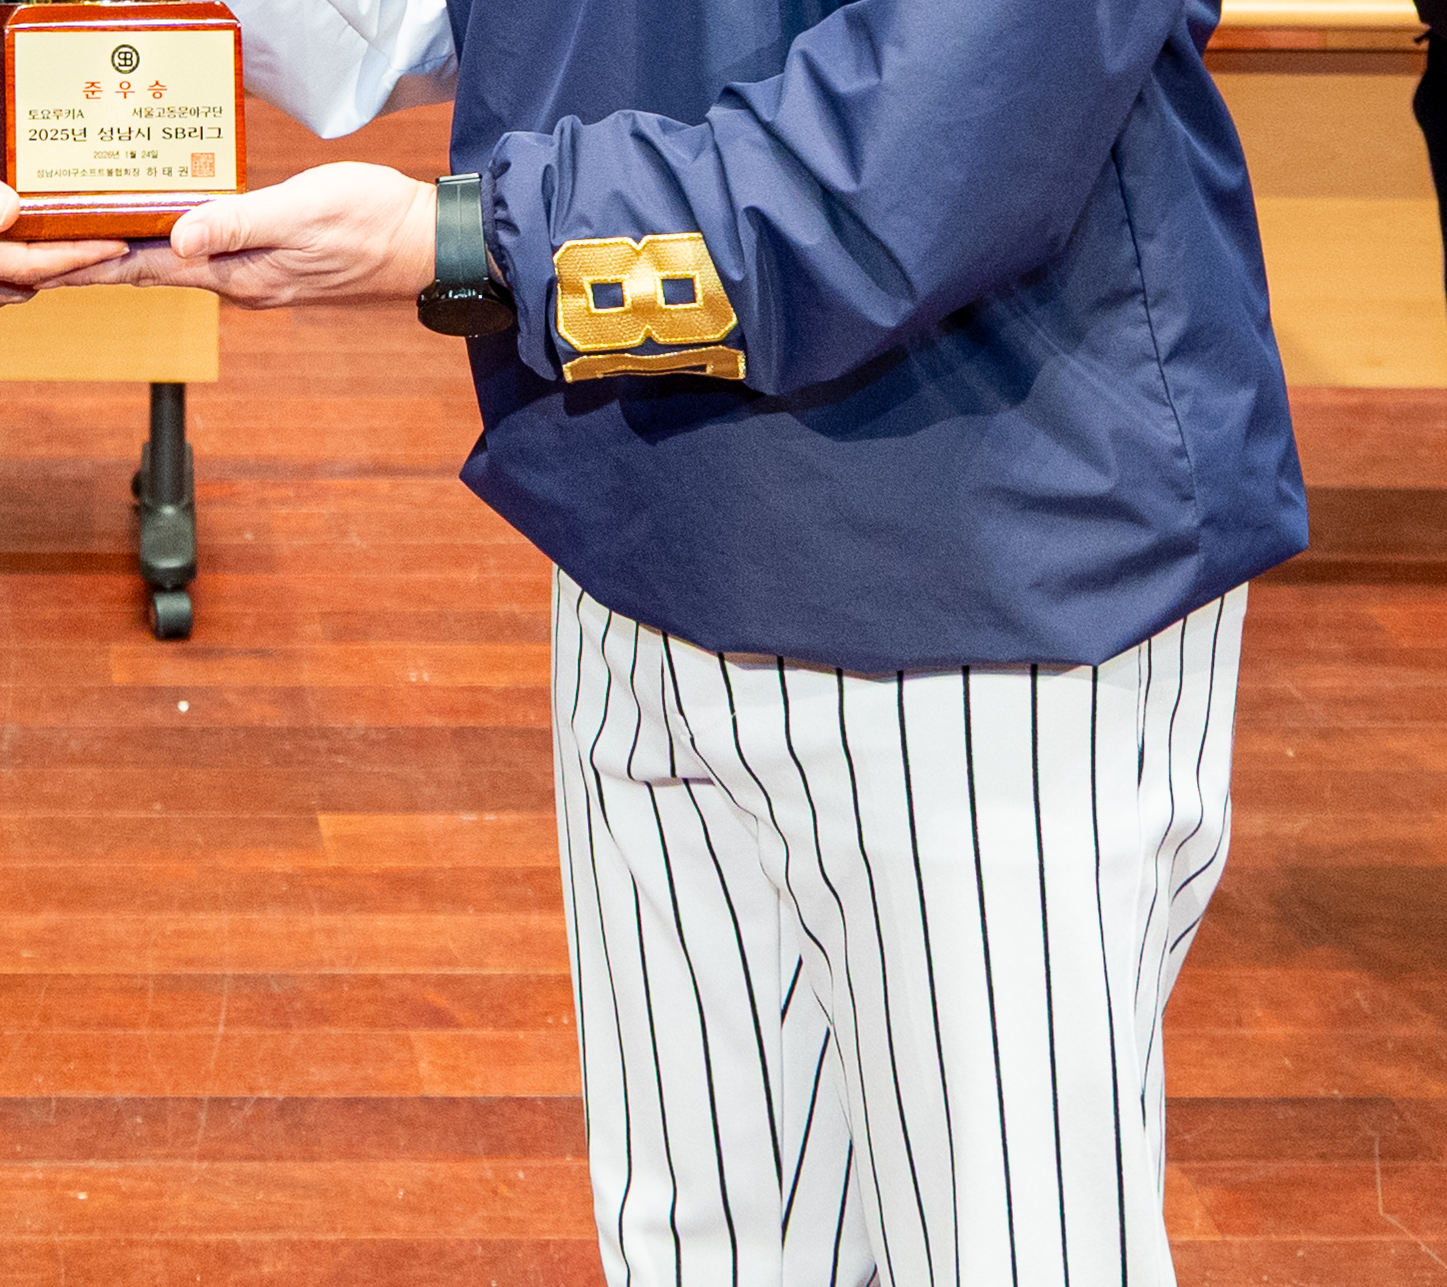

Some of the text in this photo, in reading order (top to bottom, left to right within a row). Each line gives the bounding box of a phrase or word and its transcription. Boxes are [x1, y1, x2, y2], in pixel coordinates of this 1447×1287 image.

[28, 125, 224, 142] 2025년 성남시 SB리그
